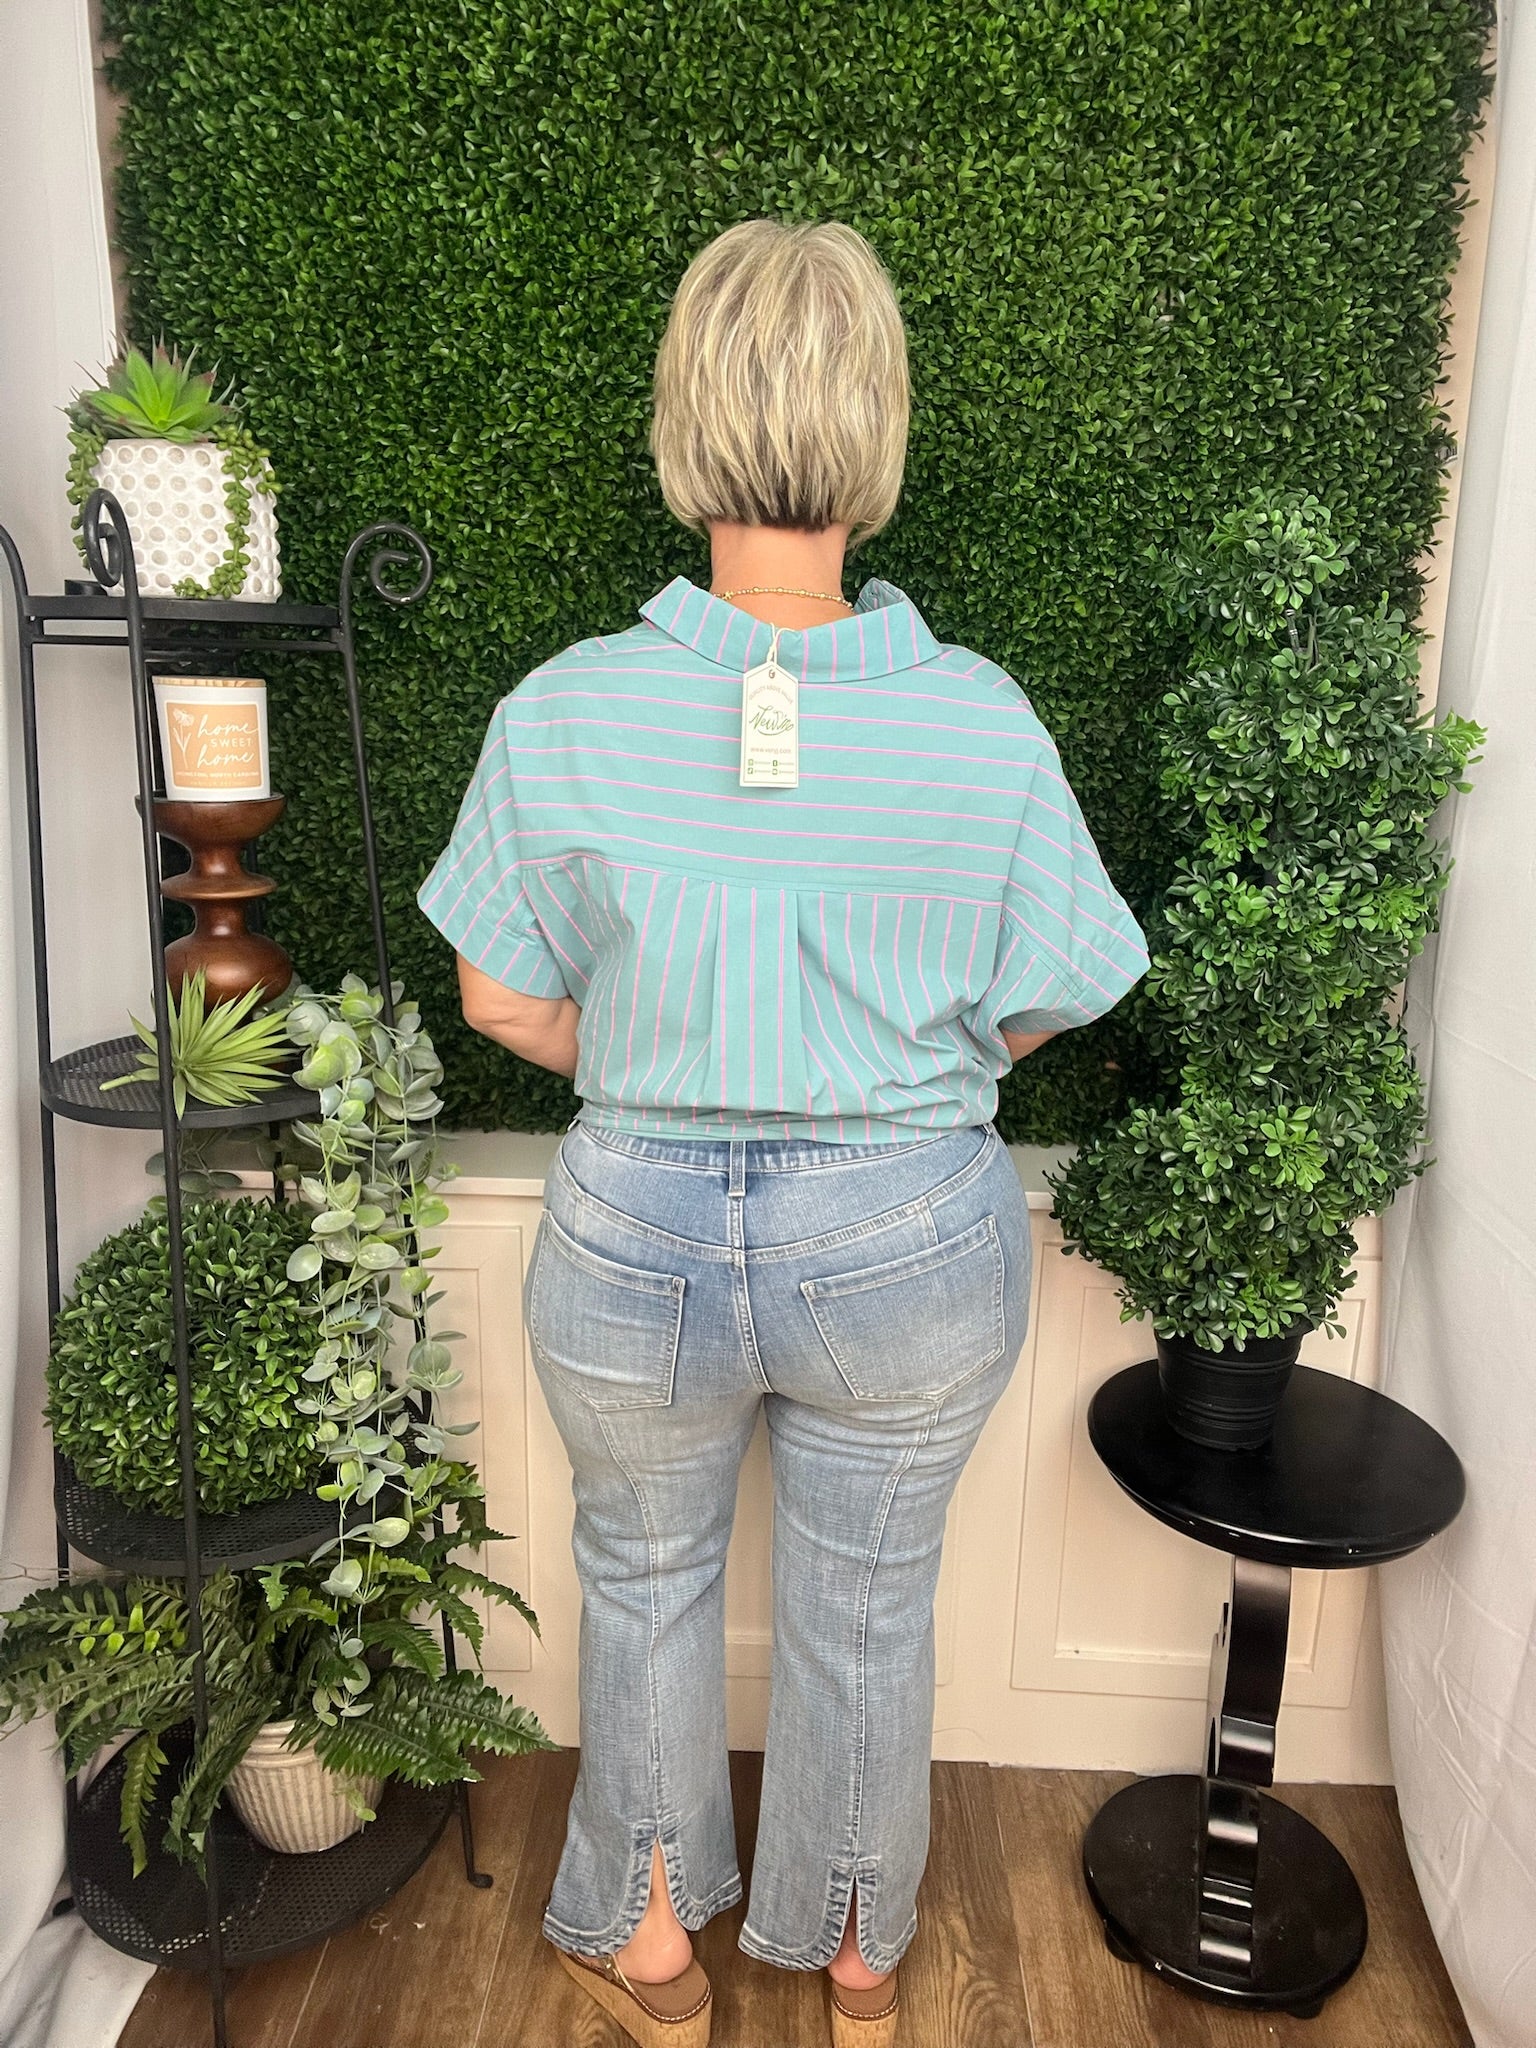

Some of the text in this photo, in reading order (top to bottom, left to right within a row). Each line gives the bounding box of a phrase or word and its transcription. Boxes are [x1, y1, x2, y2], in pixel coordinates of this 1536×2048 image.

[197, 714, 257, 738] home
[210, 738, 252, 748] SWEET
[197, 744, 254, 769] home
